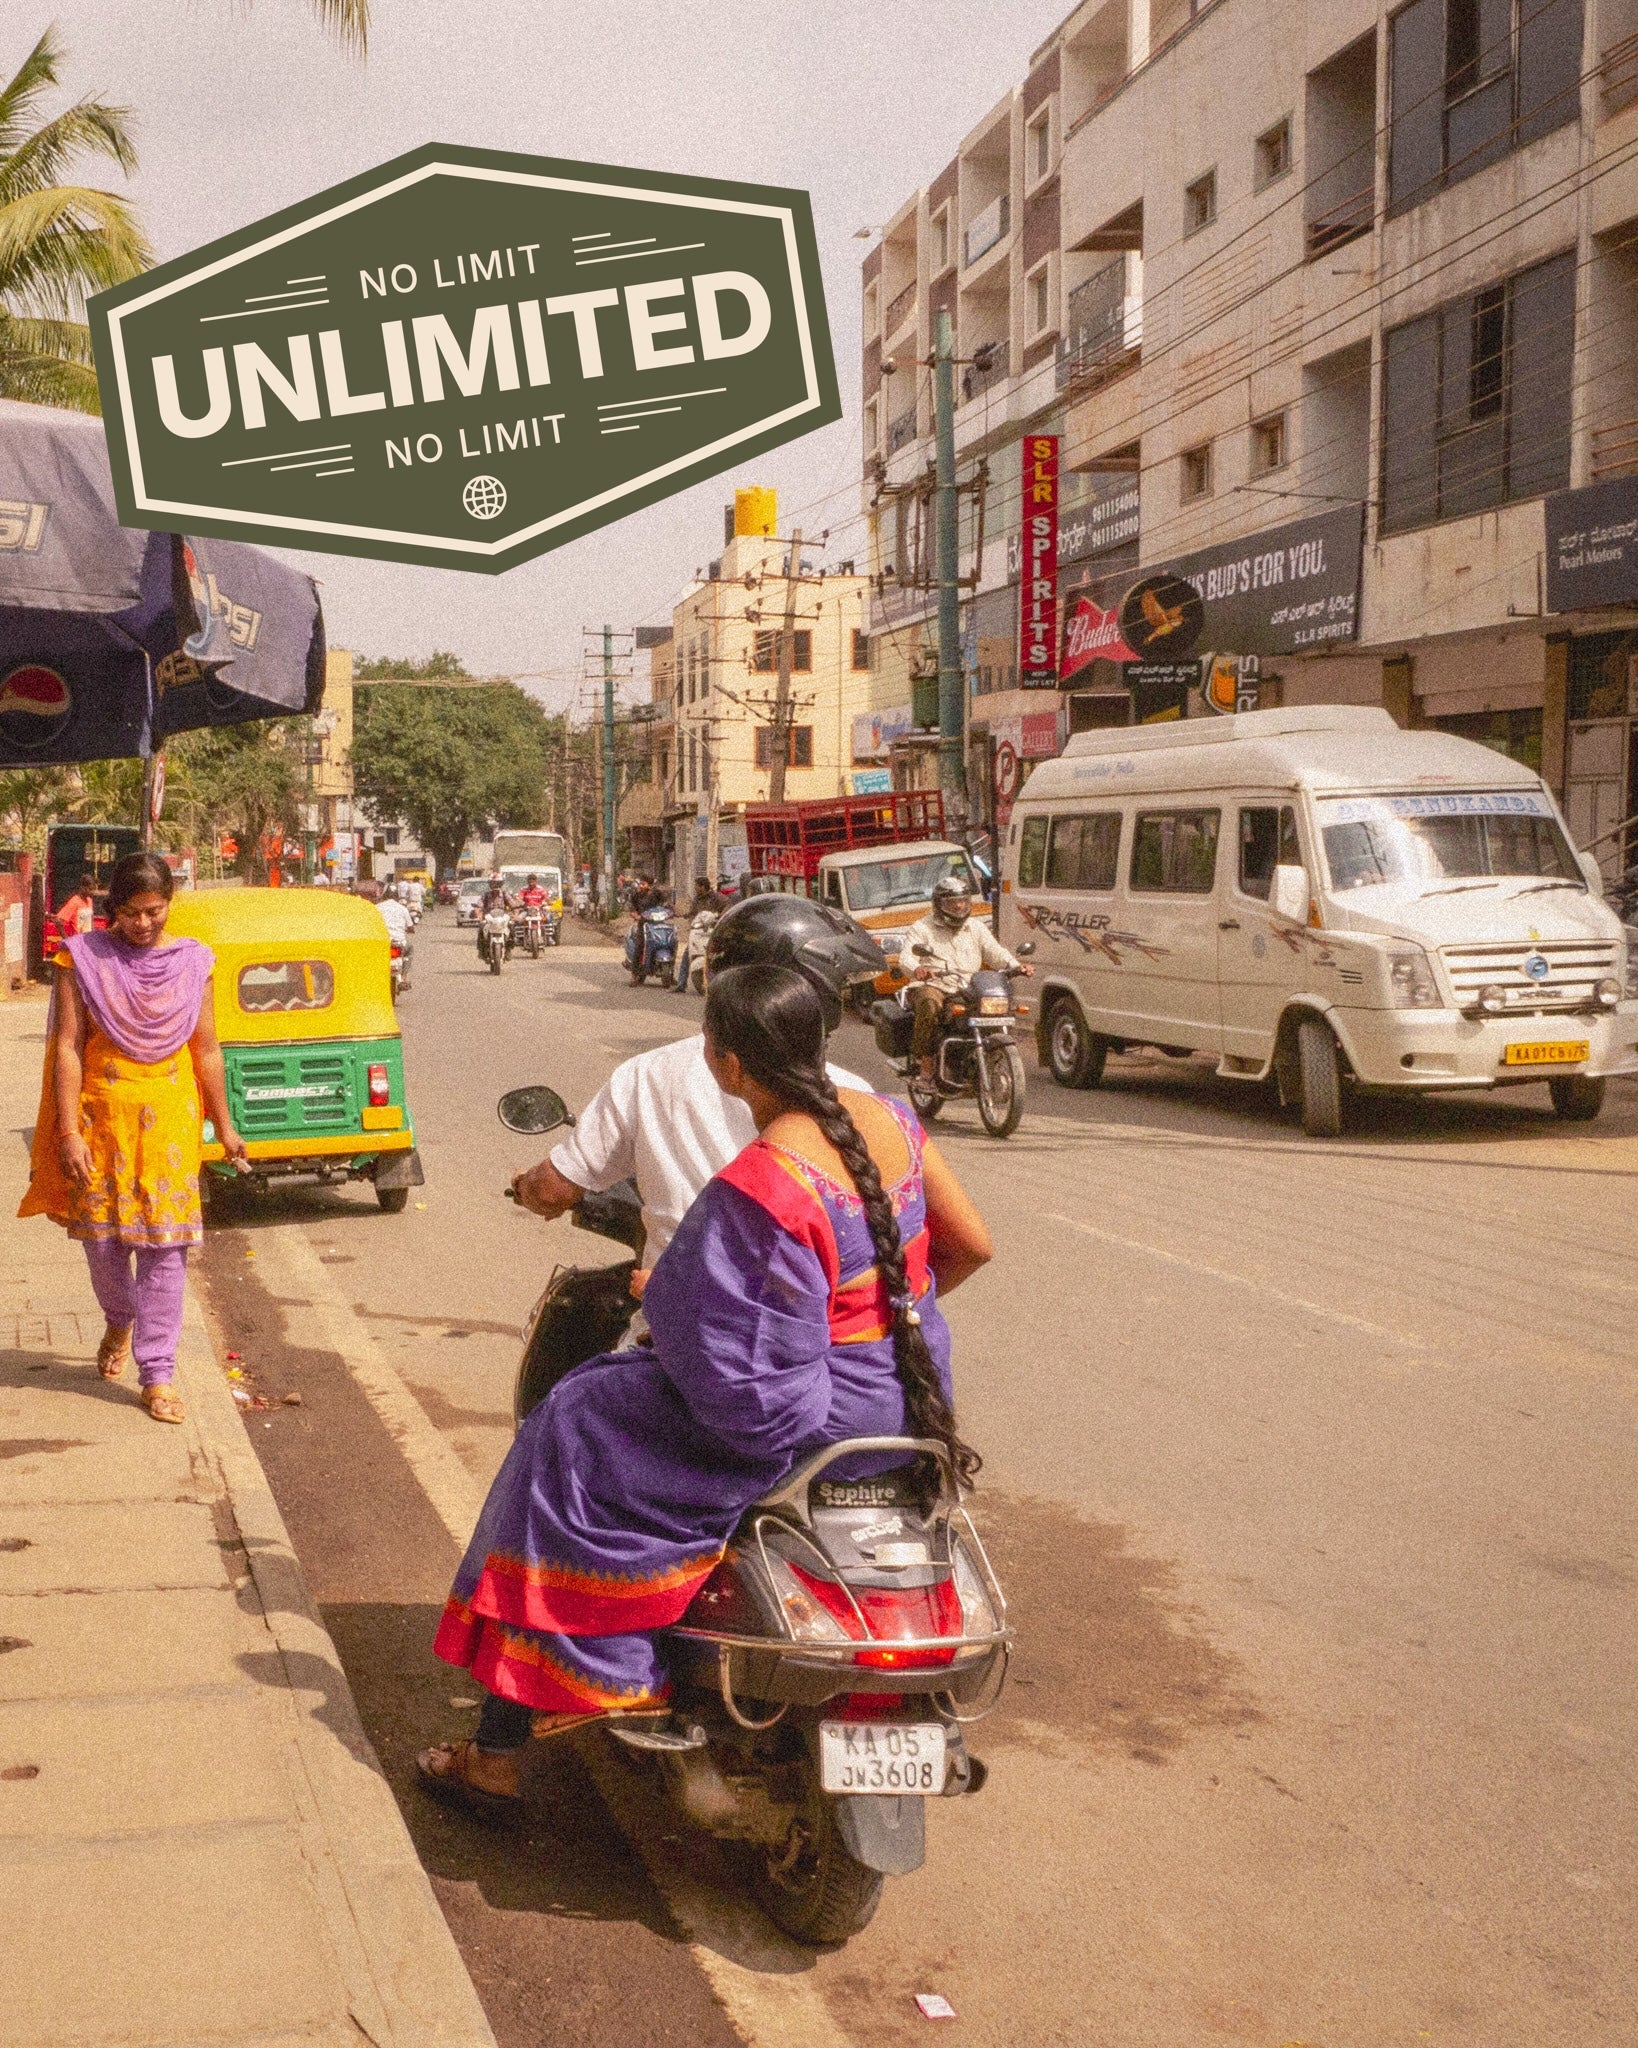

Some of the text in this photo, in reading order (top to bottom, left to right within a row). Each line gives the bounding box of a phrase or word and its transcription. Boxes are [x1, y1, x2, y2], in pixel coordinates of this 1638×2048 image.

[1030, 440, 1053, 664] SLR SPIRITS
[1207, 559, 1250, 600] BUD'S
[1253, 551, 1284, 589] FOR
[1289, 539, 1327, 580] YOU.
[1317, 622, 1353, 640] SPIRITS
[820, 1482, 896, 1500] Saphire
[844, 1727, 919, 1757] KA 05
